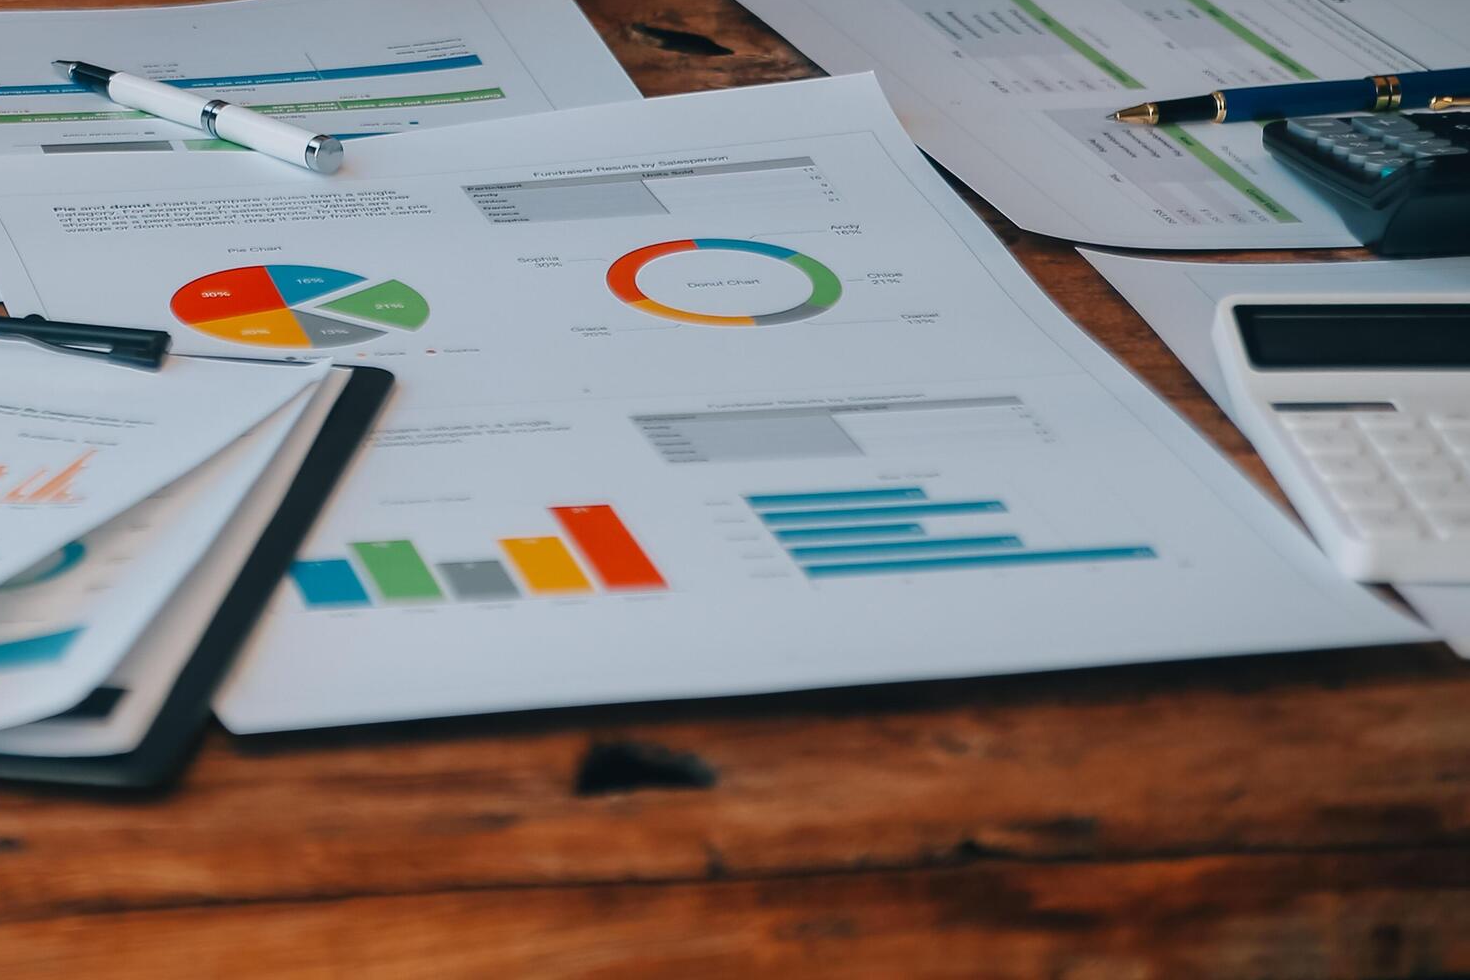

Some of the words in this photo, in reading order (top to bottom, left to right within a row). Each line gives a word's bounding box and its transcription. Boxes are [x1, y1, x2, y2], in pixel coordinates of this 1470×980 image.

[532, 168, 593, 178] Fundraiser
[595, 164, 639, 173] Results
[657, 156, 730, 167] Salesperson
[467, 183, 522, 192] Participant
[109, 202, 151, 210] donut
[830, 224, 861, 232] Andy
[227, 246, 248, 255] Pie
[249, 244, 283, 253] Chart
[517, 256, 560, 264] Sophia
[296, 277, 326, 285] 16%
[686, 280, 723, 289] Donut
[726, 278, 761, 286] Chart
[200, 290, 232, 299] 30%
[374, 301, 406, 310] 21%
[320, 328, 351, 336] 13%
